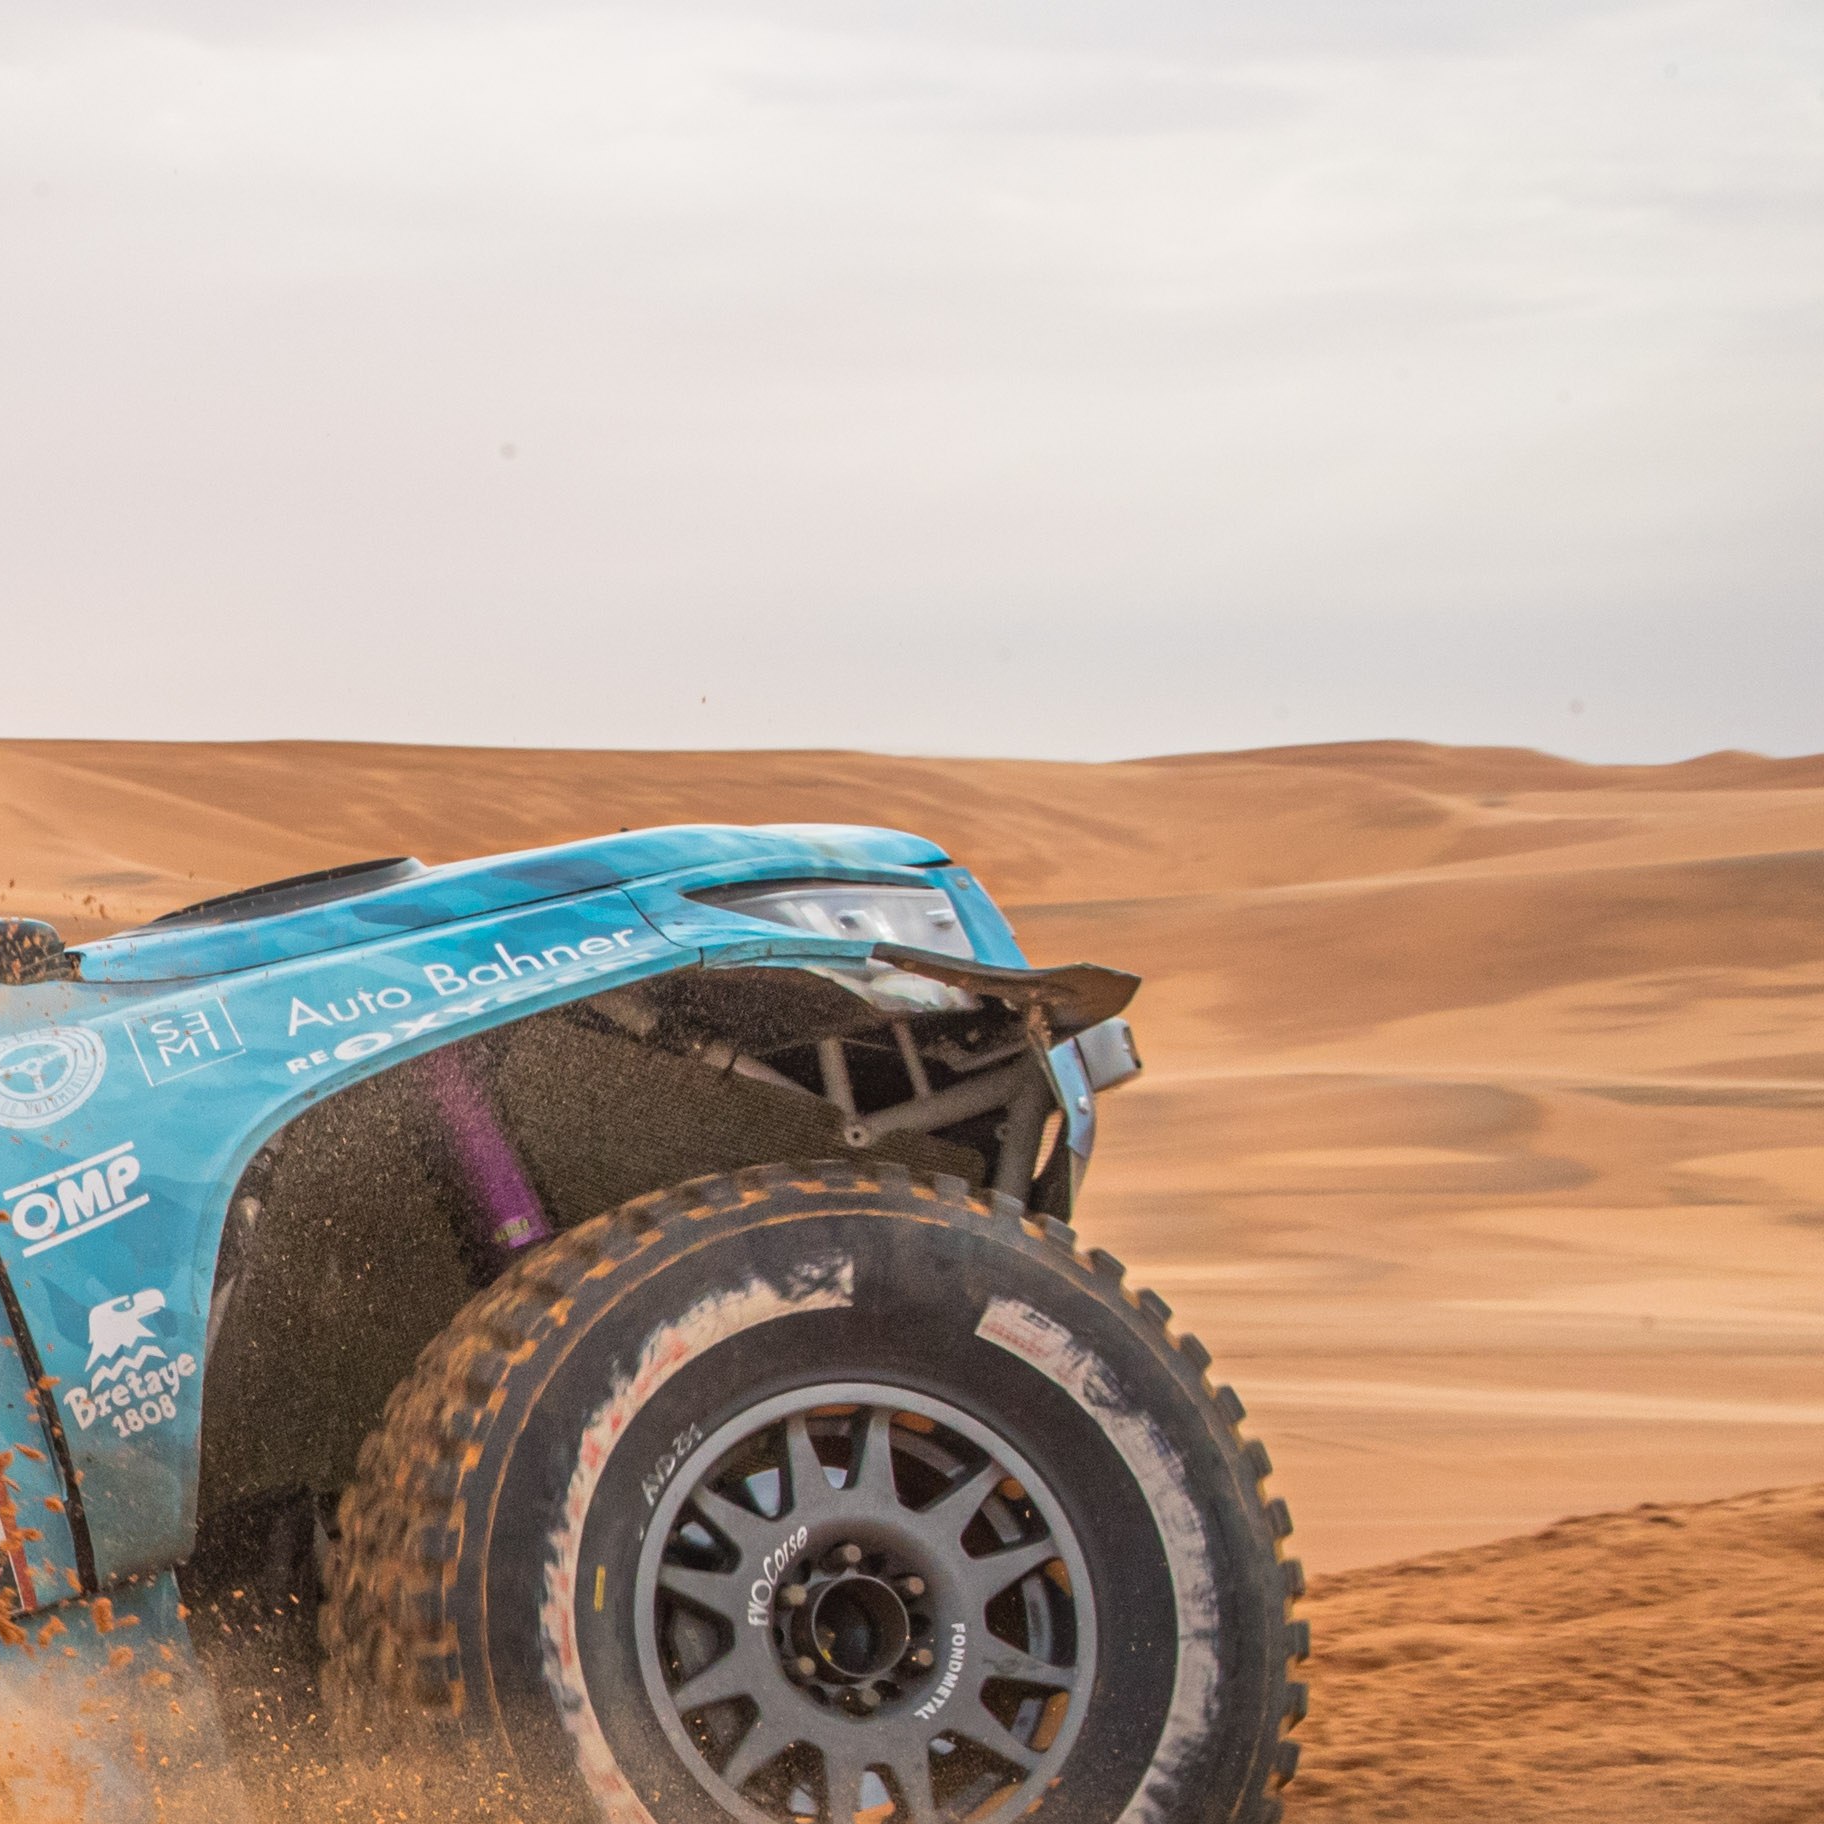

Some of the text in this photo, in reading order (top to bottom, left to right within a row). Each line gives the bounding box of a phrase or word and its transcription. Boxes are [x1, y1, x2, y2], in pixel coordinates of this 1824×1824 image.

[287, 928, 635, 1037] Auto Bahner
[12, 1154, 141, 1240] OMP
[63, 1352, 197, 1430] Bretaye
[111, 1394, 178, 1438] 1808
[913, 1622, 966, 1720] FONDMETAL
